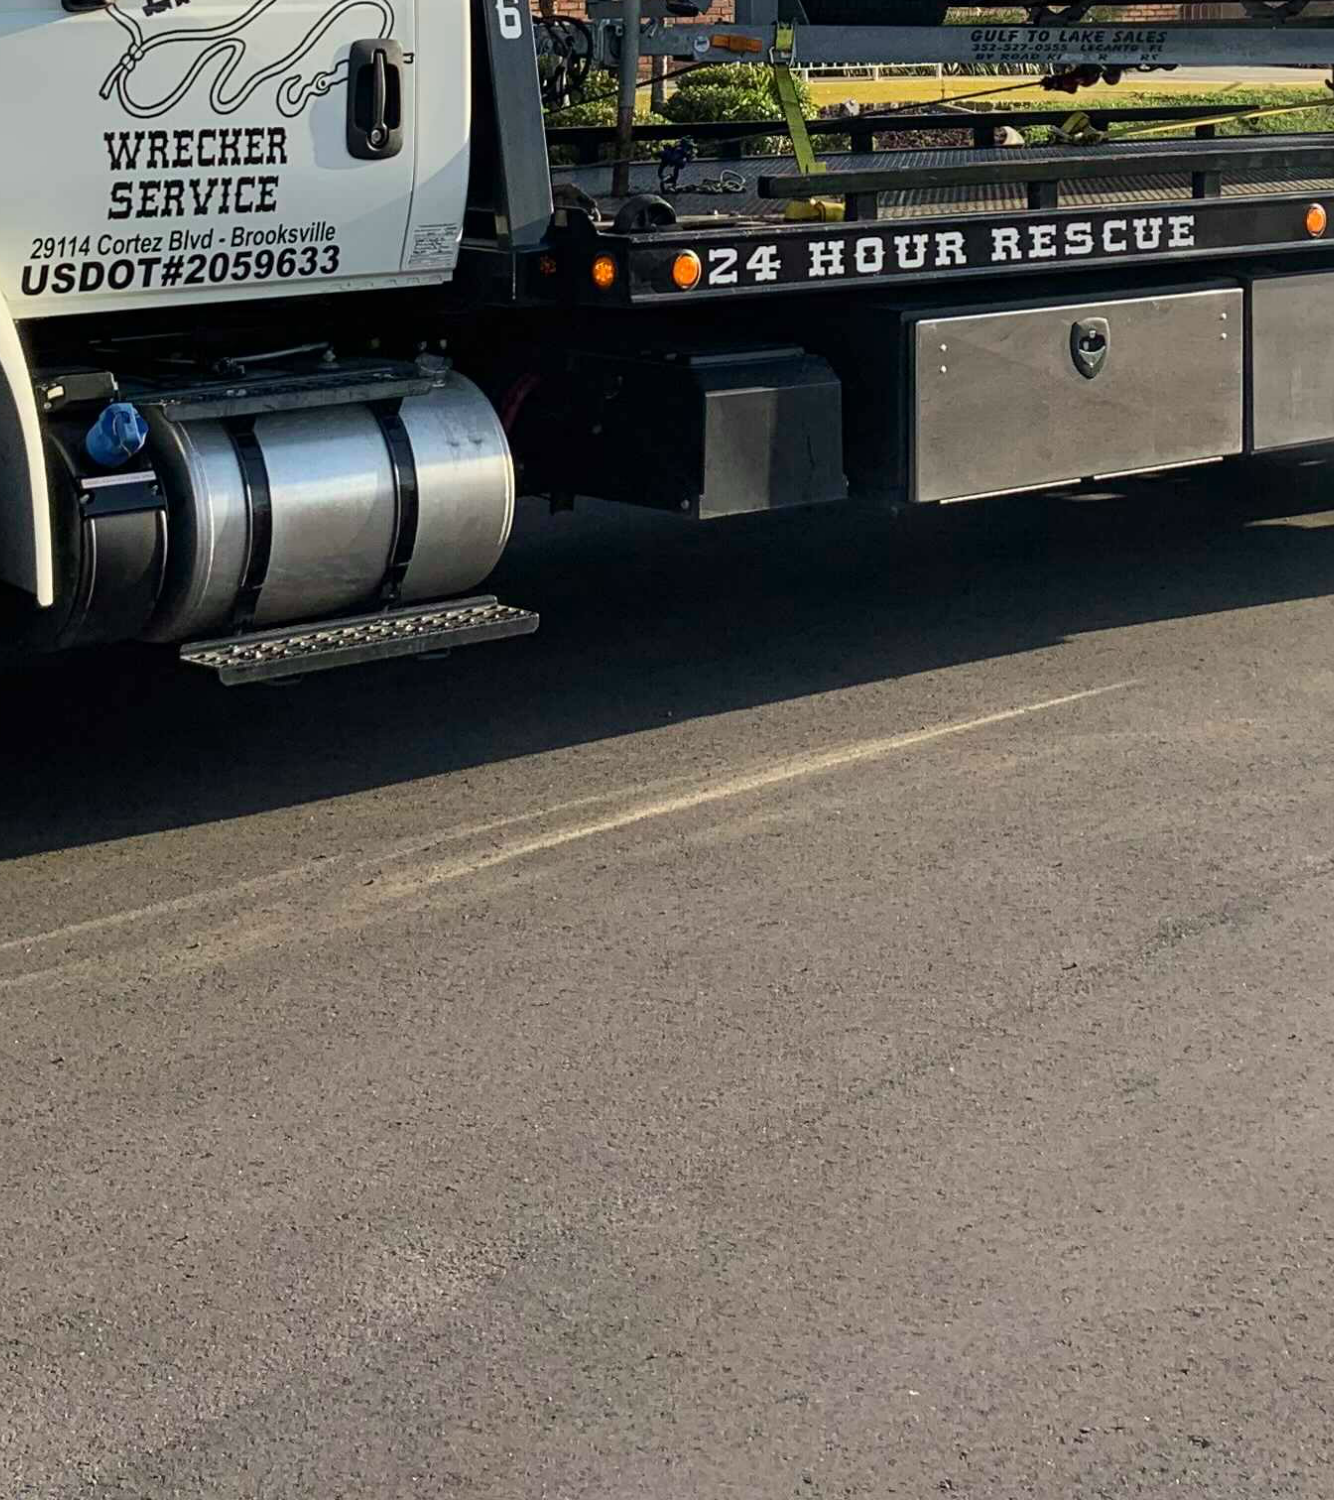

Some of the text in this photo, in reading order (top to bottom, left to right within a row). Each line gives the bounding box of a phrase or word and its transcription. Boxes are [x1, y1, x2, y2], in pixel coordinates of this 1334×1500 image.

[970, 30, 1168, 43] GULF TO LAKE SALES
[104, 127, 287, 170] WRECKER
[107, 175, 279, 219] SERVICE
[30, 236, 90, 259] 29114
[97, 233, 162, 256] Cortez
[168, 228, 213, 251] Blvd
[231, 222, 336, 248] Brooksville
[708, 215, 1196, 285] 24 HOUR RESCUE
[21, 245, 340, 296] USDOT#2059633
